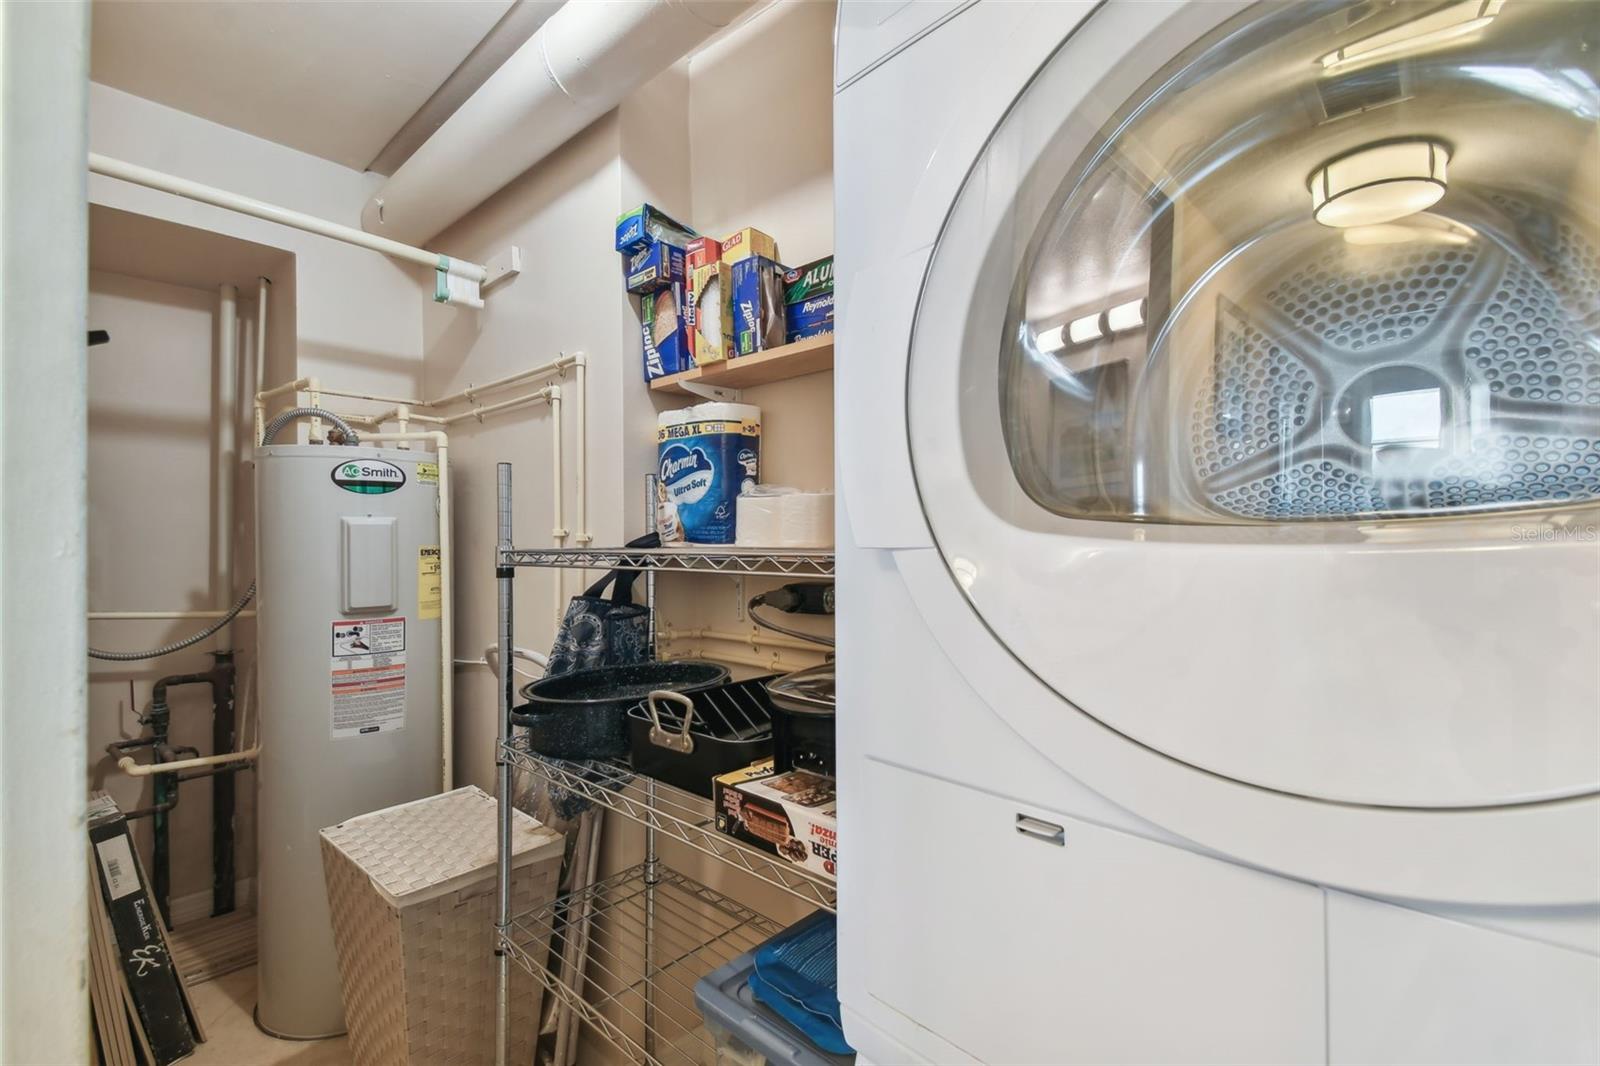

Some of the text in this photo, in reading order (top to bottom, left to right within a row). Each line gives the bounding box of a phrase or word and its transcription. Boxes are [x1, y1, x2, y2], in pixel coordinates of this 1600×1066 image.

[721, 234, 742, 251] GLAD
[741, 300, 756, 333] Ziploc
[642, 326, 665, 379] Ziploc
[667, 425, 690, 438] MEGA
[692, 424, 702, 435] XL
[661, 454, 698, 481] Charmin
[673, 478, 707, 497] Ultra Soft
